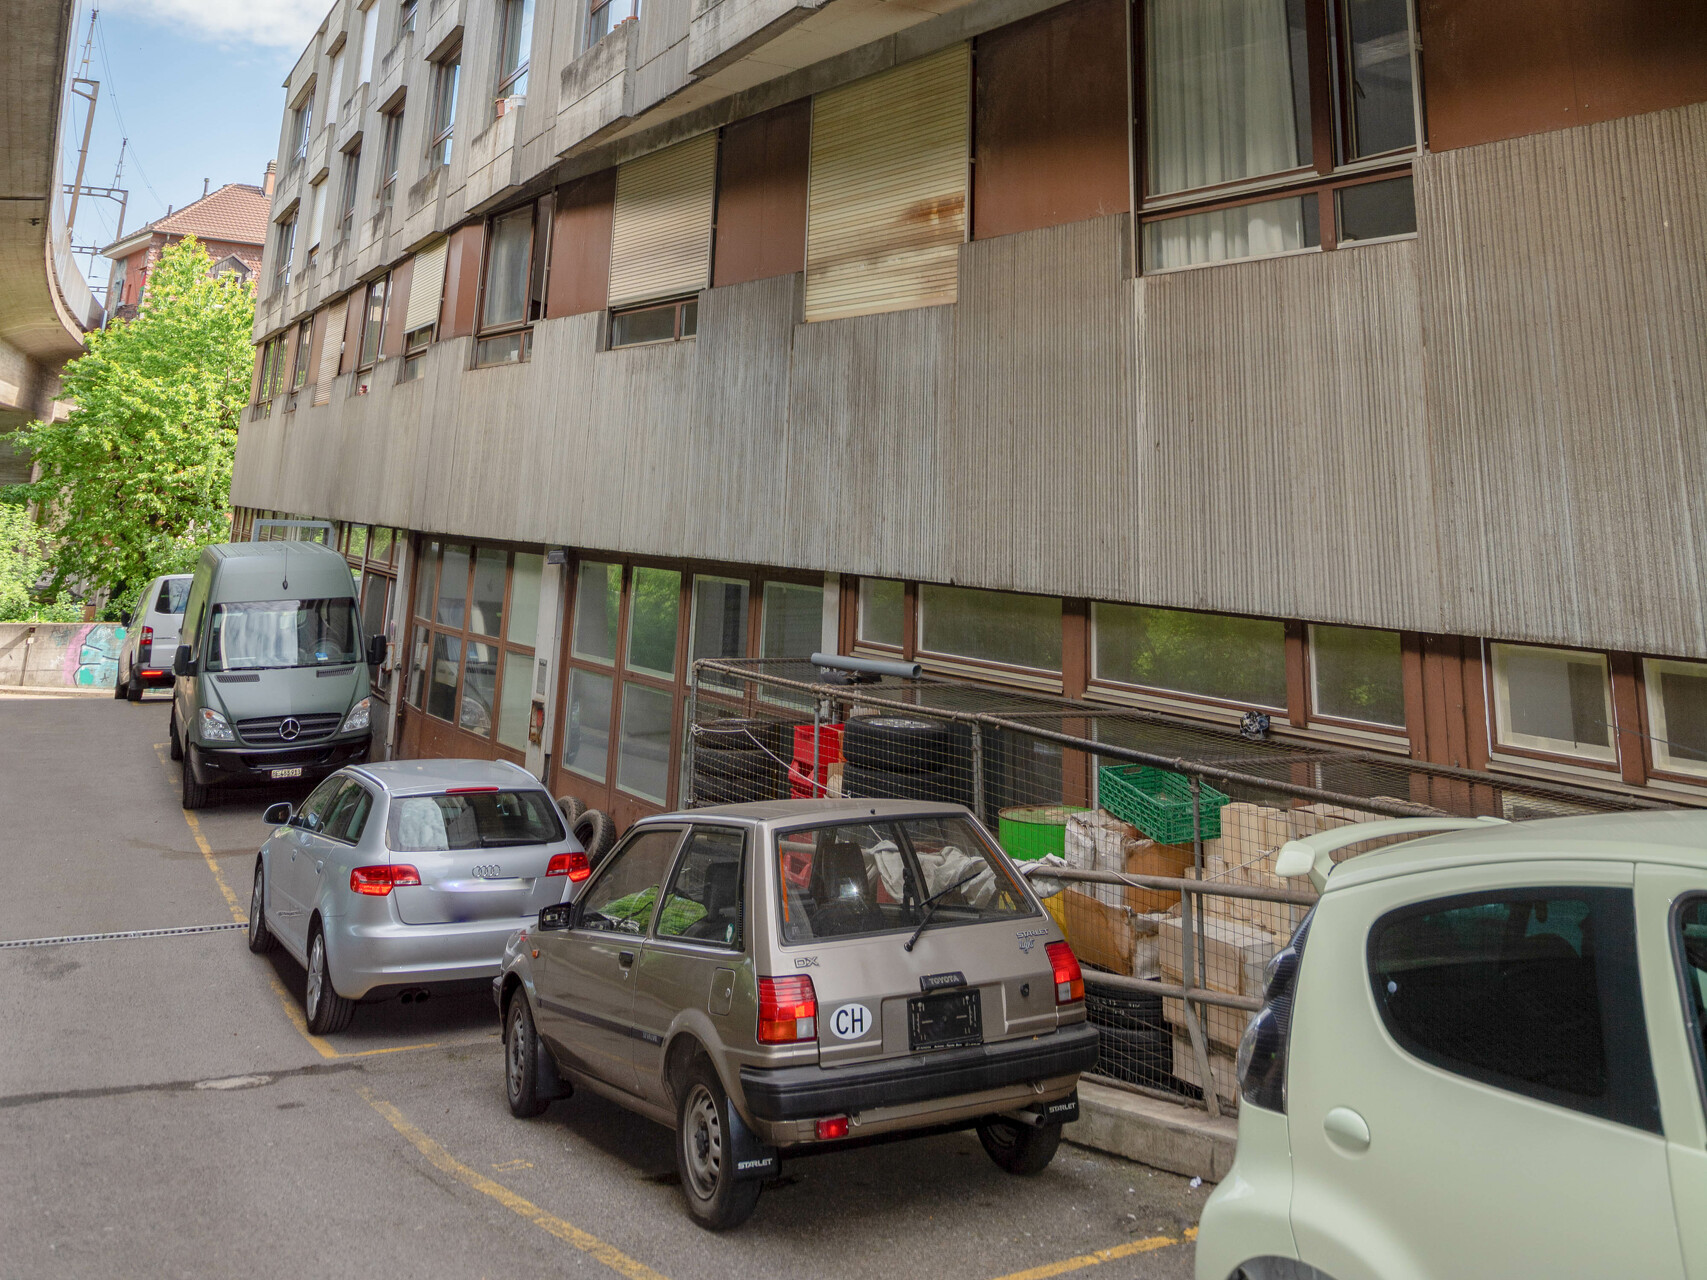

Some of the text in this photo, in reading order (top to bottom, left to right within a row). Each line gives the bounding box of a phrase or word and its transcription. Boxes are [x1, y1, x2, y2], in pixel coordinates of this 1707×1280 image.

[1016, 928, 1048, 939] STARLET
[794, 956, 819, 968] DX
[928, 974, 960, 985] TOYOTA
[836, 1007, 864, 1035] CH
[1049, 1102, 1076, 1113] STARLET
[737, 1157, 773, 1170] STARLET
